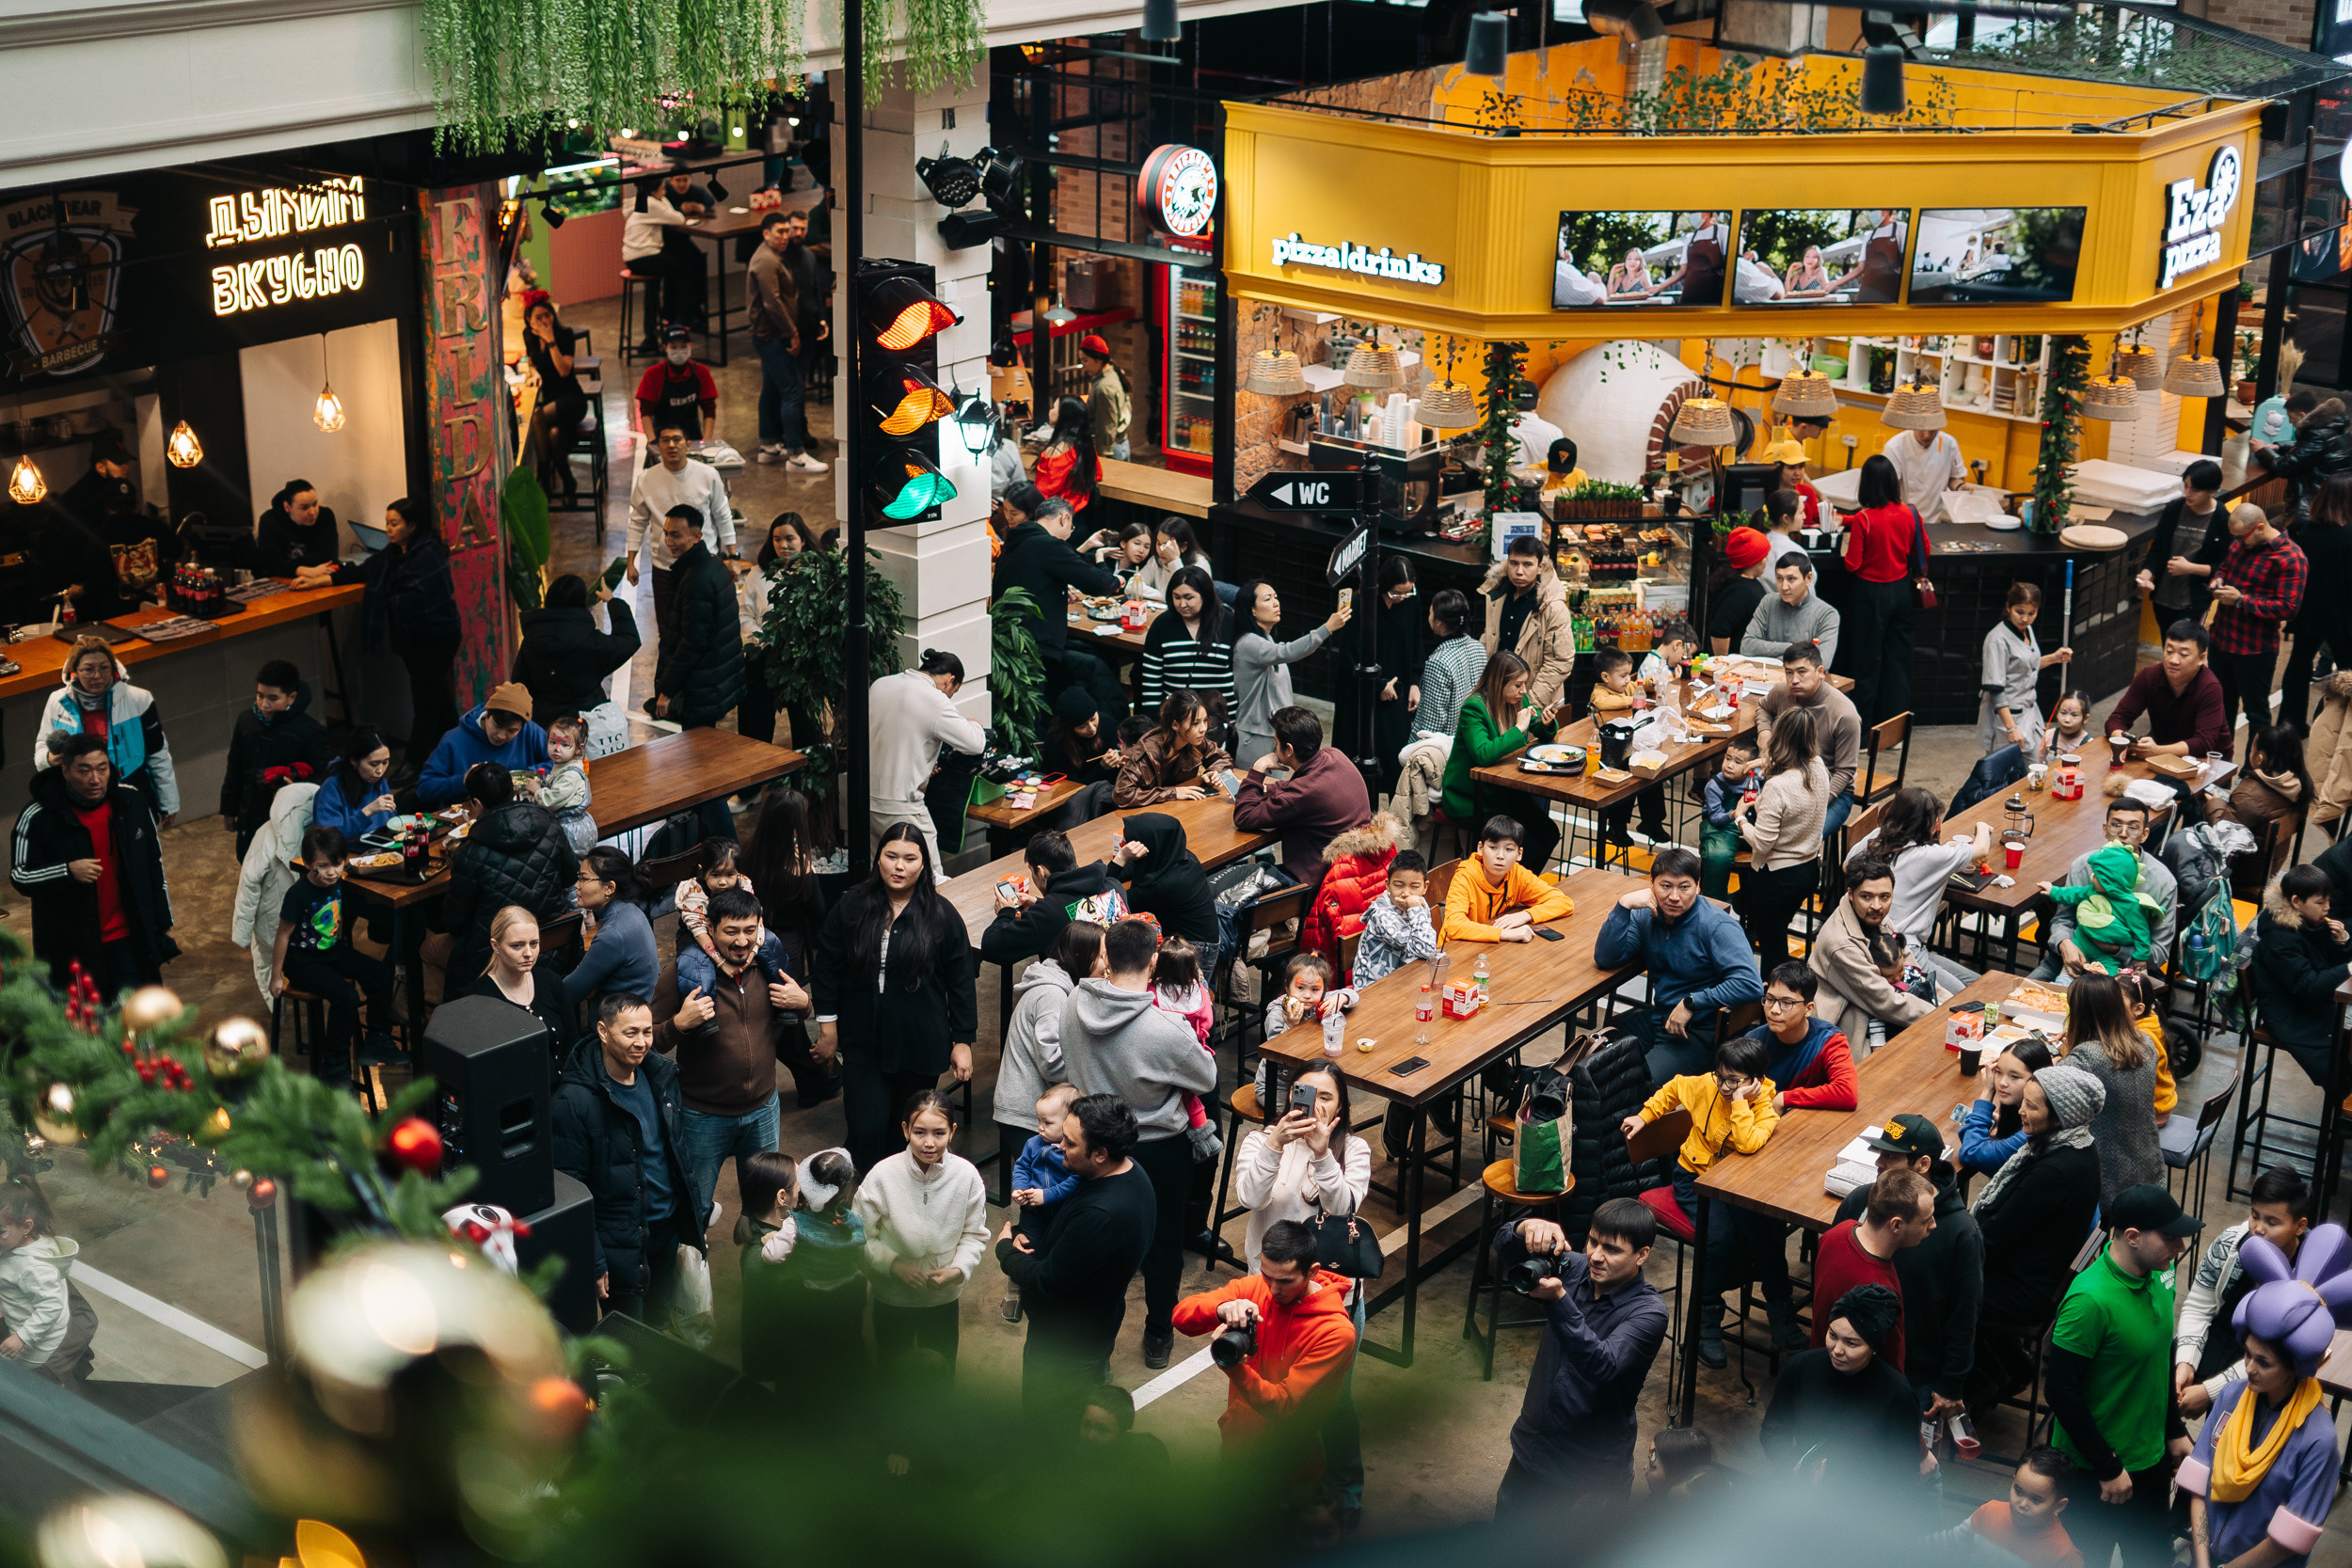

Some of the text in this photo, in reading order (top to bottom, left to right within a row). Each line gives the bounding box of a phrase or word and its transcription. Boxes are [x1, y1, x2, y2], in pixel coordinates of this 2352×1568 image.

[2168, 178, 2227, 243] Eza
[212, 243, 365, 316] ВКУСНО
[2162, 230, 2221, 290] pizza
[41, 339, 99, 368] BARBECUE
[434, 197, 497, 552] FRIDA
[1298, 482, 1330, 505] WC
[1341, 529, 1368, 572] MARKET
